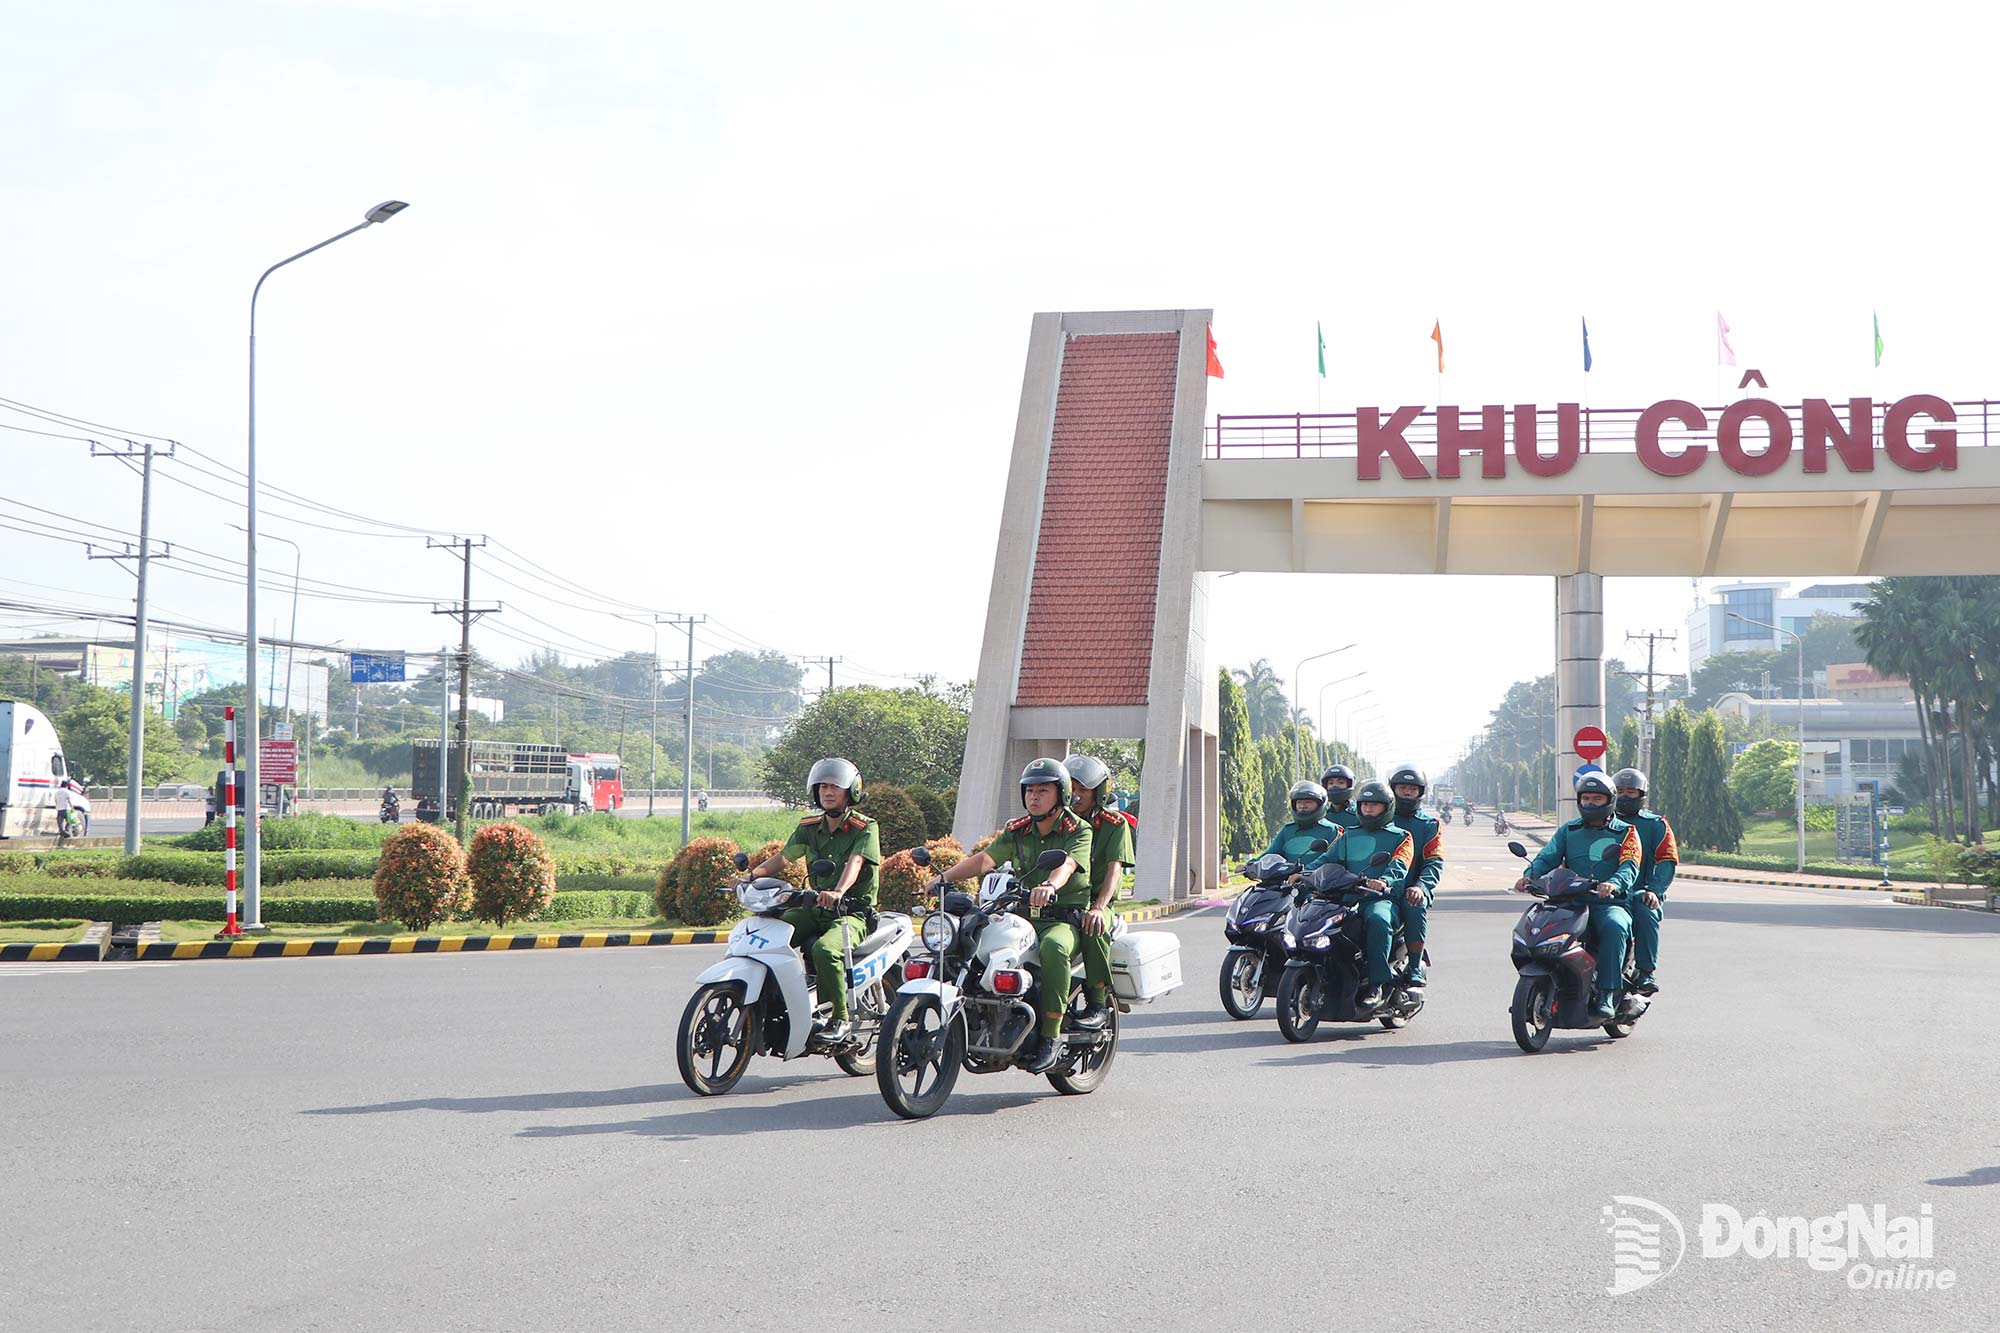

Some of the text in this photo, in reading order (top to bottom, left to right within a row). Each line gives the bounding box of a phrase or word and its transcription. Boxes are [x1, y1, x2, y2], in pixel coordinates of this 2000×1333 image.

[1357, 369, 1957, 480] KHU CÔNG
[846, 951, 889, 990] STT
